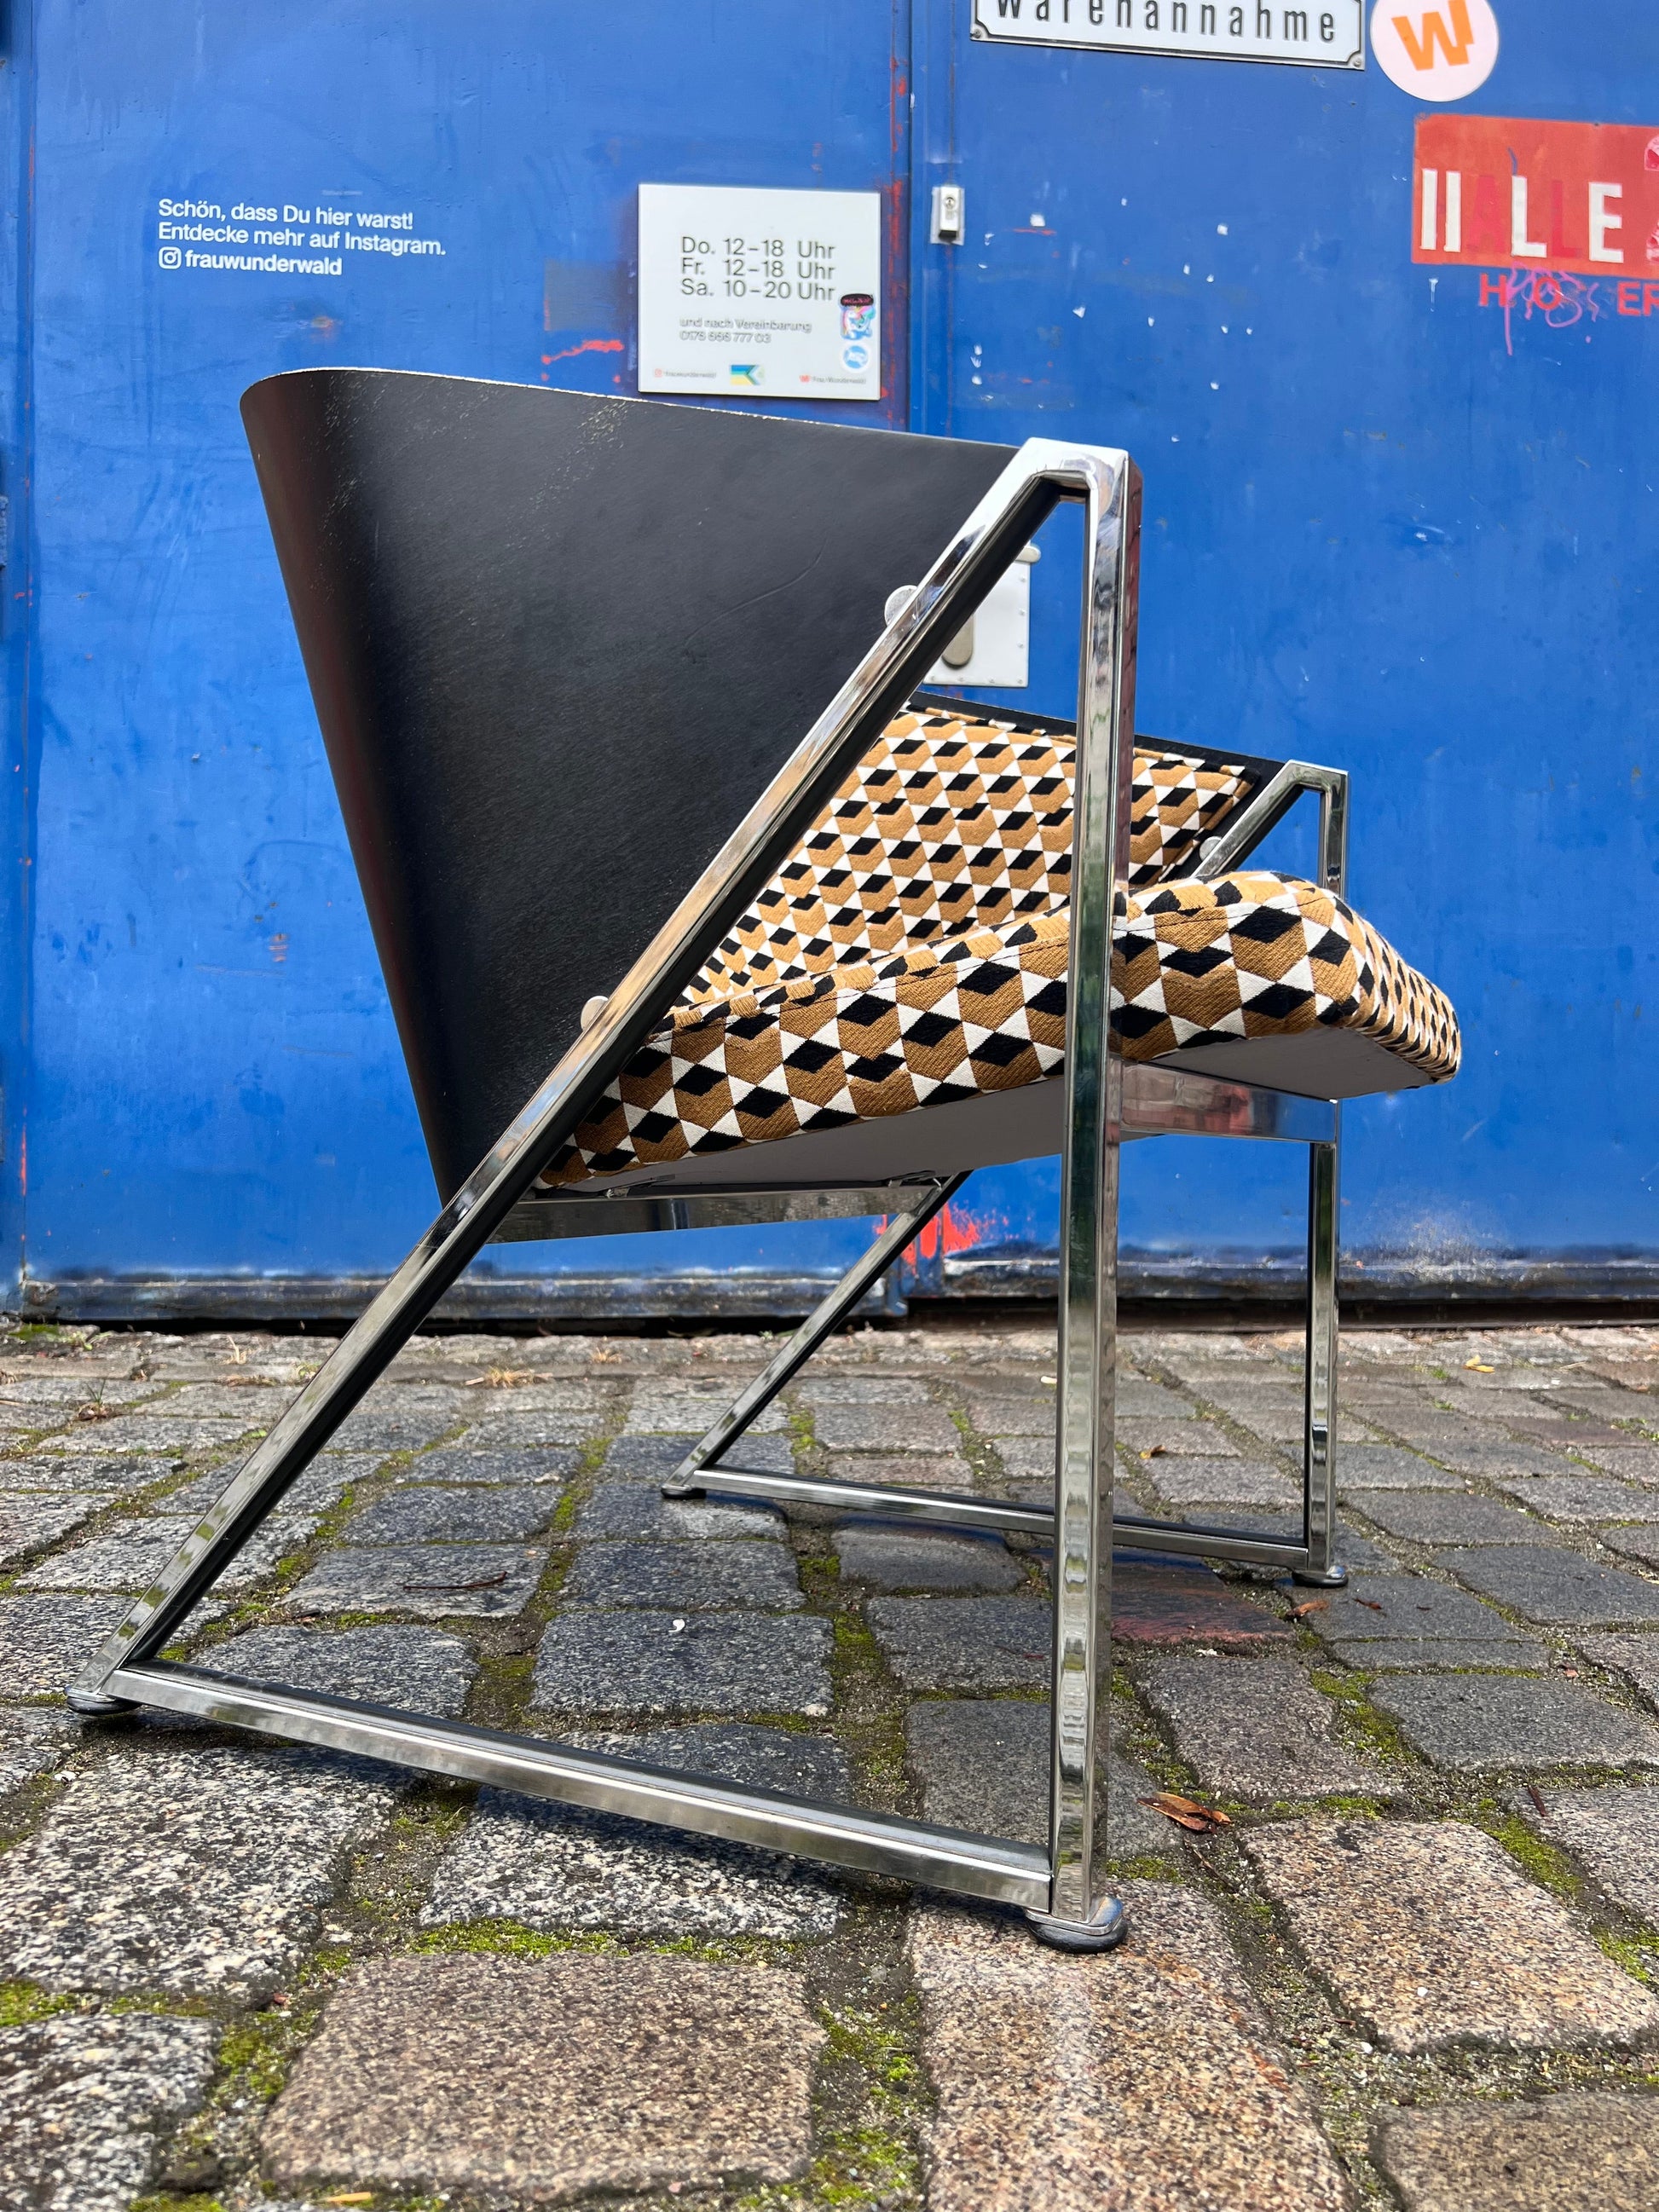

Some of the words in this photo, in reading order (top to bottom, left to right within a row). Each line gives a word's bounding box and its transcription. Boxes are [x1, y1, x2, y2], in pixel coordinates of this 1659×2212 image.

[159, 198, 226, 222] Schön,
[231, 203, 278, 222] dass
[283, 205, 310, 224] Du
[315, 206, 352, 226] hier
[356, 211, 413, 230] warst!
[159, 222, 249, 244] Entdecke
[254, 228, 305, 246] mehr
[309, 230, 340, 249] auf
[344, 232, 447, 257] Instagram.
[681, 236, 715, 255] Do.
[797, 240, 836, 259] Uhr
[185, 249, 343, 275] frauwunderwald
[681, 257, 706, 275] Fr.
[797, 261, 836, 280] Uhr
[680, 278, 714, 297] Sa.
[797, 281, 836, 301] Uhr
[679, 318, 703, 328] und
[704, 319, 734, 329] nach
[735, 319, 812, 334] Vereinbarung
[732, 332, 754, 343] 777
